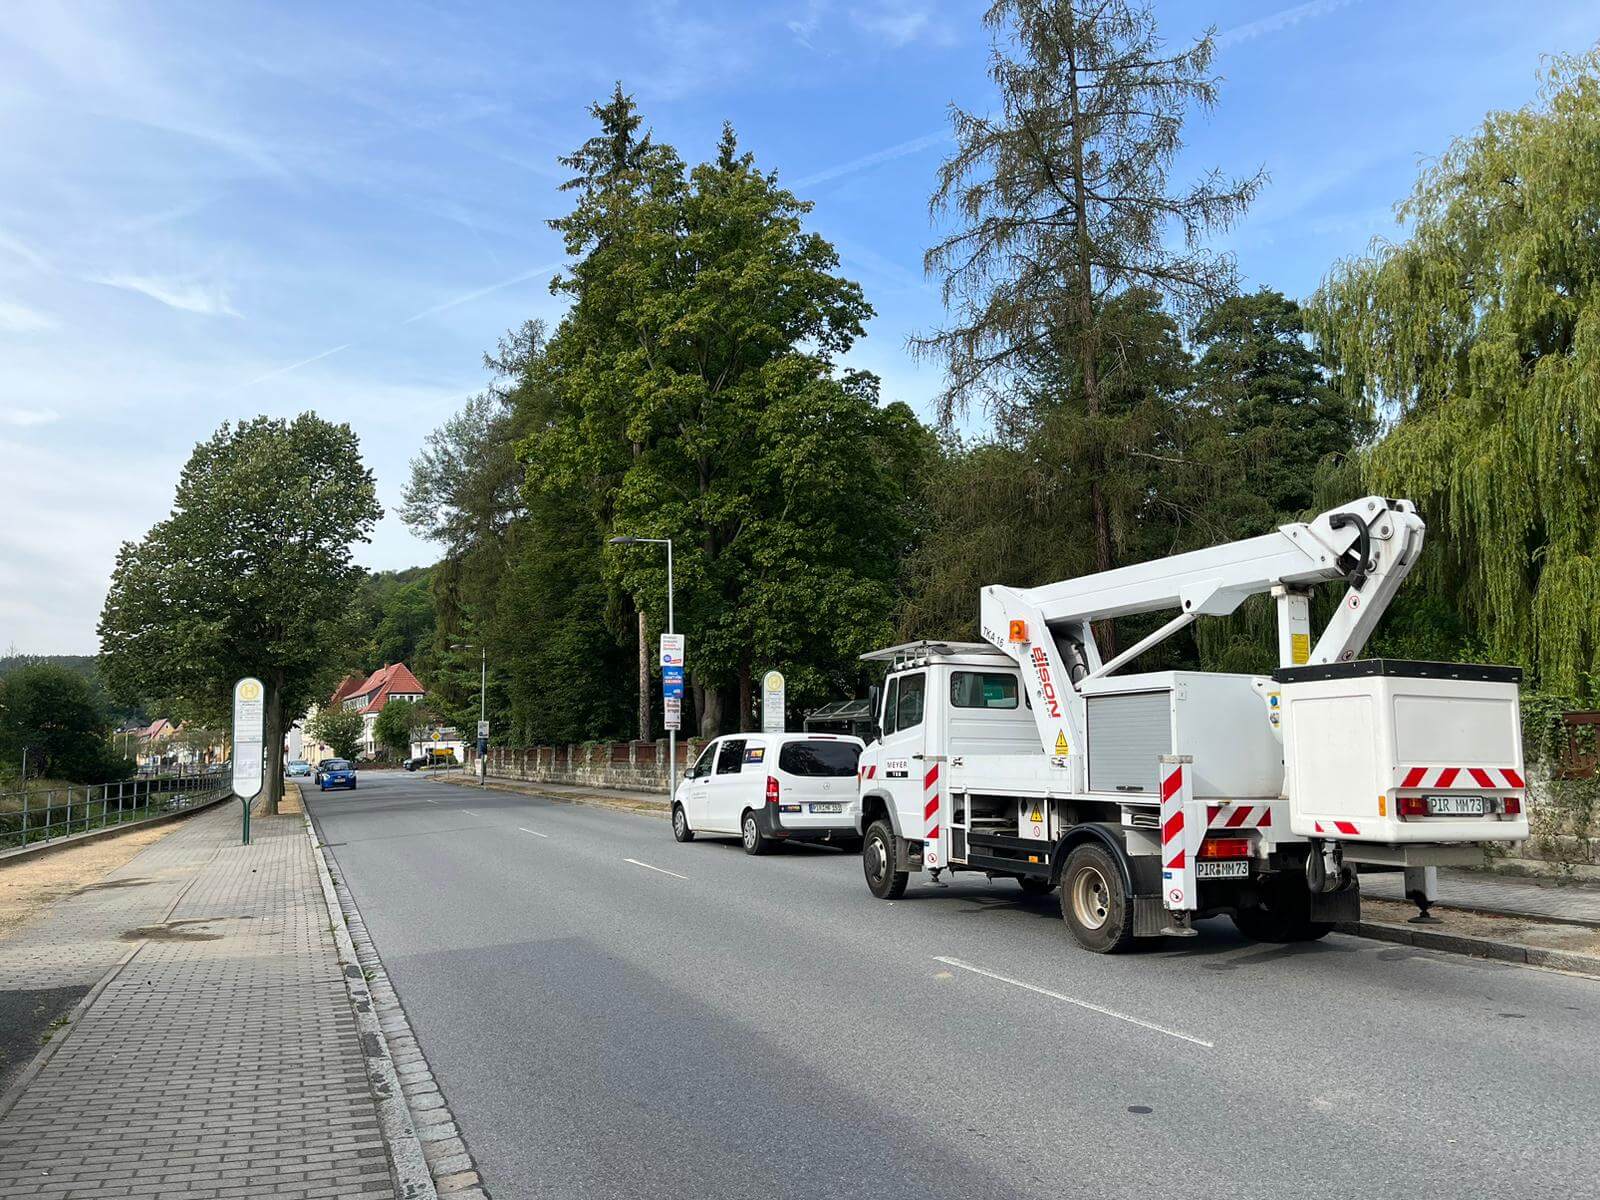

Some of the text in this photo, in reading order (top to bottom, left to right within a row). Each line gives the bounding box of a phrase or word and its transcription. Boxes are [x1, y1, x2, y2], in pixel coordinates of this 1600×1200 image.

[983, 626, 997, 642] TKA
[1032, 646, 1062, 718] BISON
[887, 761, 907, 769] MEYER
[1430, 798, 1450, 812] PIR
[1197, 863, 1216, 876] PIR
